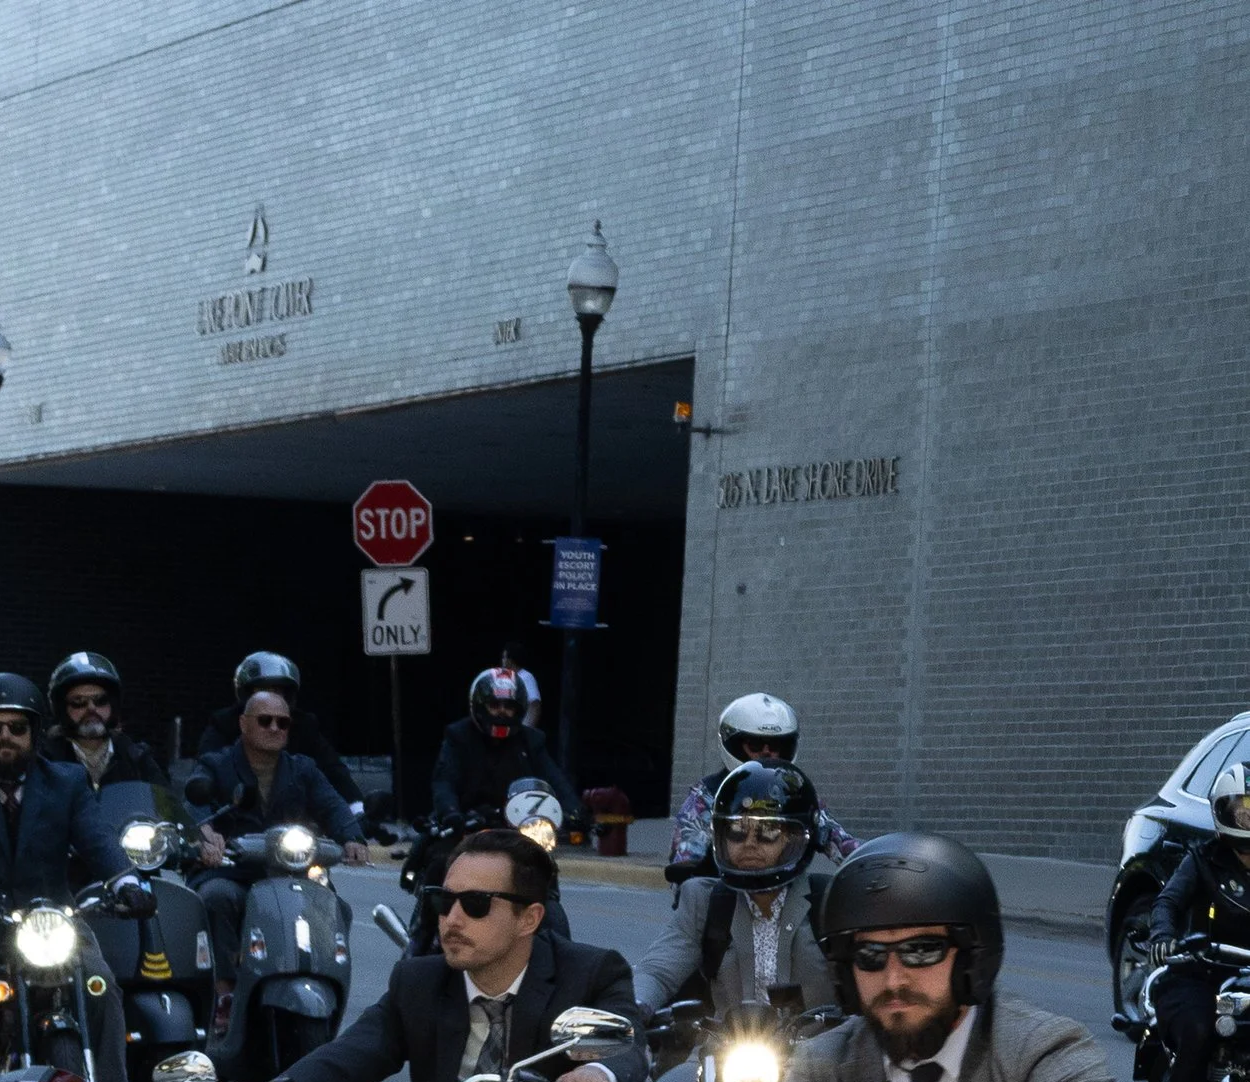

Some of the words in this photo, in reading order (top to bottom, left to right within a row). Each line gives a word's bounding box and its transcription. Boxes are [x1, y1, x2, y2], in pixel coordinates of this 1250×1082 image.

[763, 466, 800, 504] LAKE
[803, 460, 850, 501] SHORE
[855, 456, 900, 497] DRIVE
[359, 508, 427, 540] STOP
[560, 550, 595, 560] YOUTH
[558, 561, 596, 570] ESCORT
[558, 570, 594, 580] POLICY
[567, 582, 597, 591] PLACE
[372, 624, 421, 646] ONLY
[525, 793, 550, 815] 7
